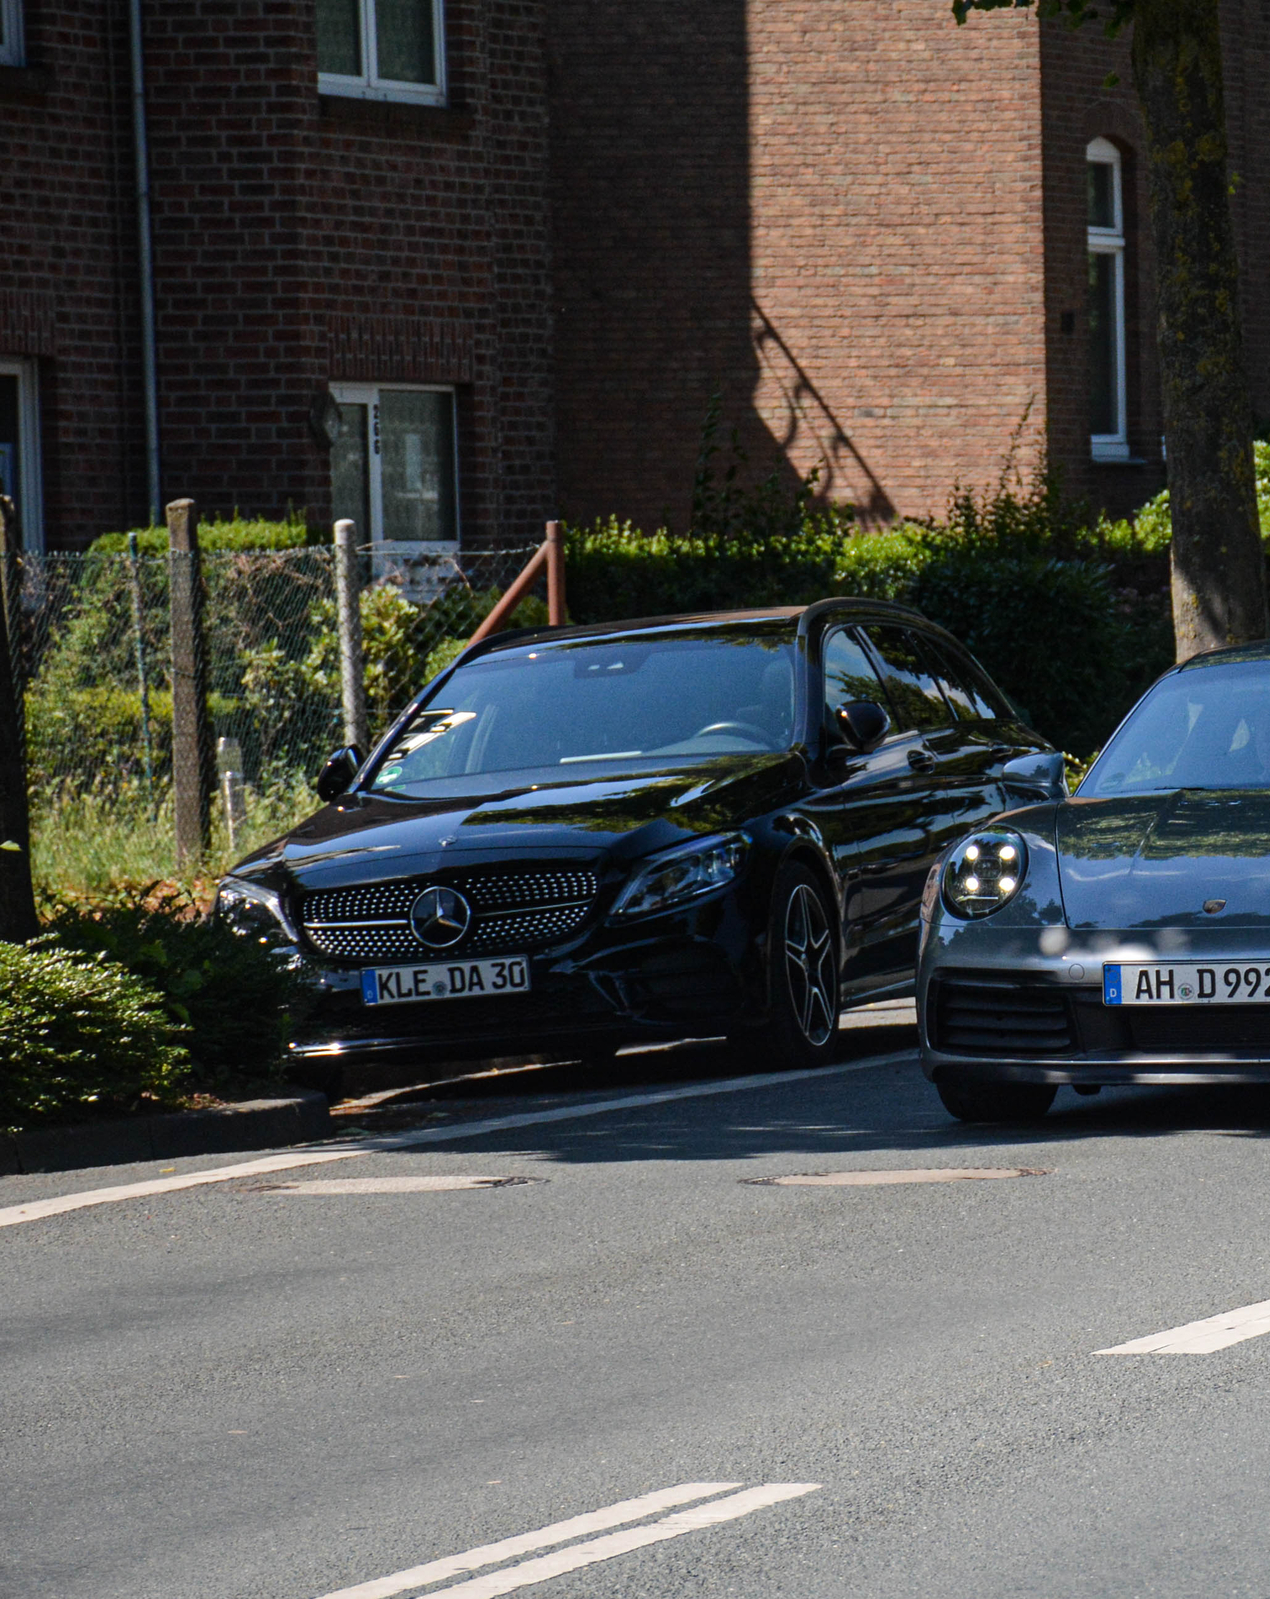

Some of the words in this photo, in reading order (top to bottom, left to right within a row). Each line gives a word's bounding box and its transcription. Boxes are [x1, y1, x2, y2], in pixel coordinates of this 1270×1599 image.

[377, 969, 432, 1000] KLE
[447, 965, 485, 994] DA
[490, 960, 527, 990] 30
[1109, 987, 1117, 998] D
[1135, 968, 1175, 1000] AH
[1196, 968, 1217, 999] D
